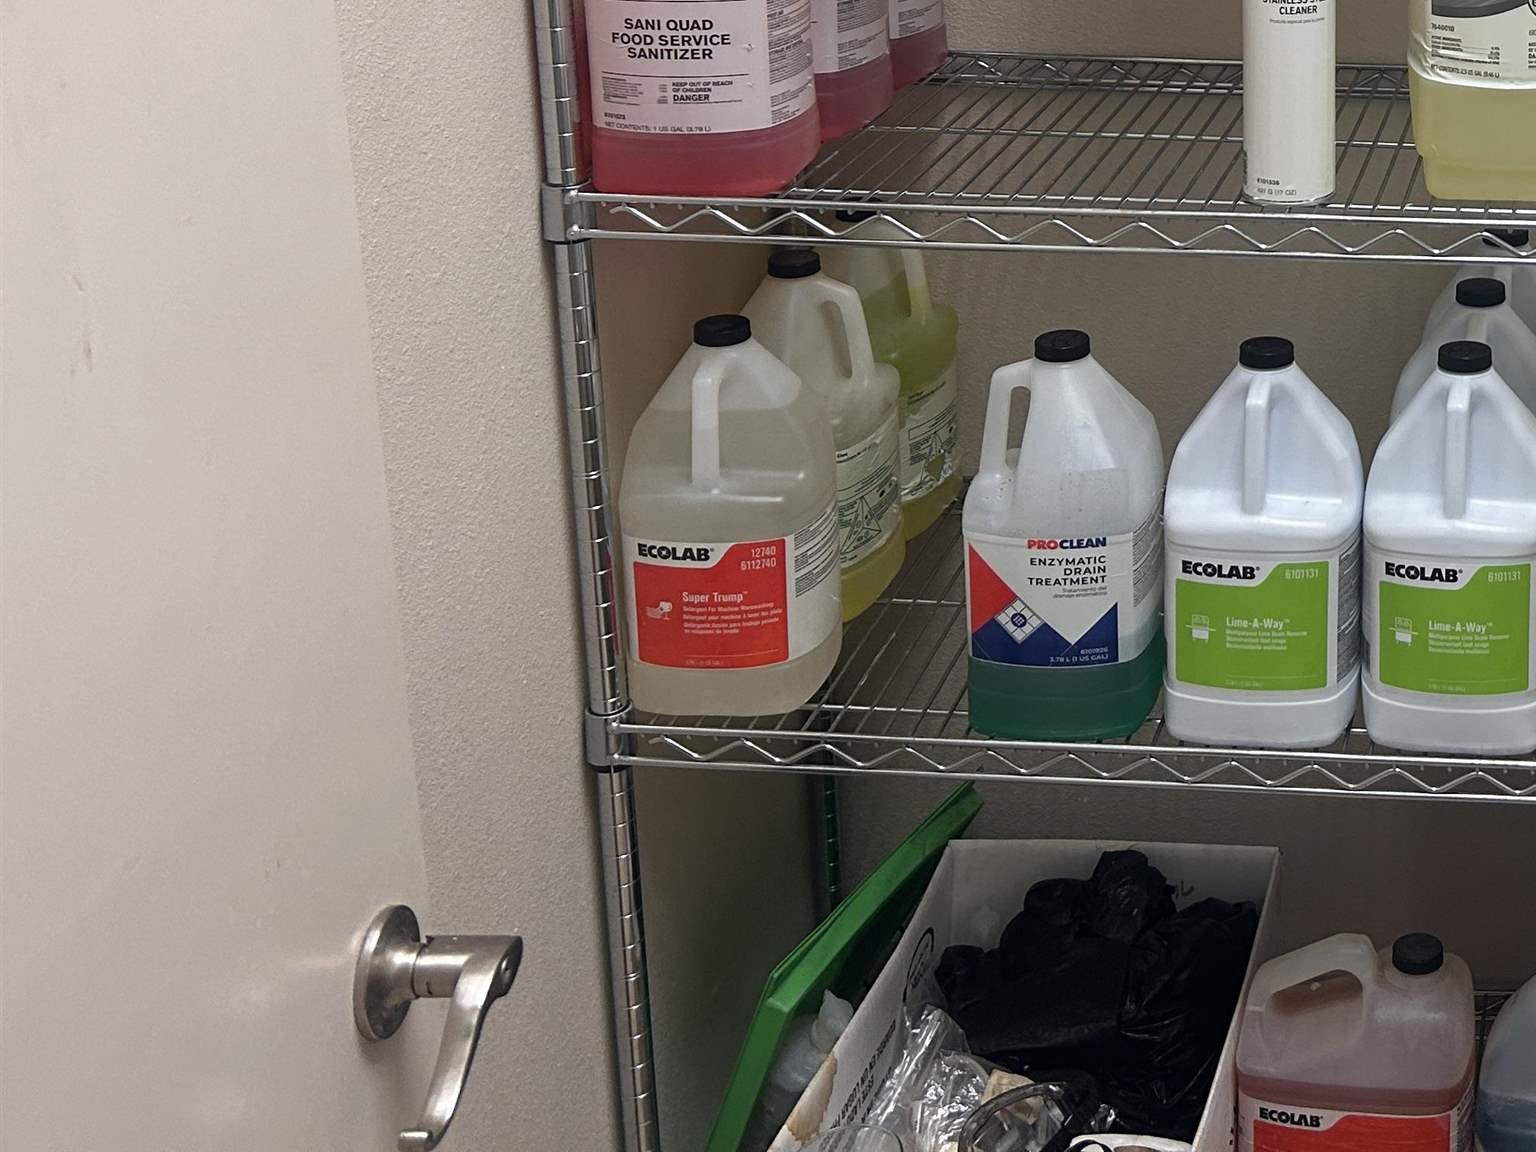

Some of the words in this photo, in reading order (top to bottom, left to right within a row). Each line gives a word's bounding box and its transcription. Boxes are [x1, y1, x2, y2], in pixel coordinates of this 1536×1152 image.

[1279, 5, 1318, 14] CLEANER
[624, 18, 661, 31] SANI
[666, 19, 714, 32] QUAD
[612, 32, 654, 46] FOOD
[658, 34, 731, 47] SERVICE
[627, 48, 713, 60] SANITIZER
[672, 94, 710, 102] DANGER
[1028, 536, 1107, 550] PROCLEAN
[637, 542, 710, 562] ECOLAB
[751, 546, 776, 558] 12740
[740, 559, 777, 571] 6112740
[1030, 555, 1106, 566] ENZYMATIC
[1063, 565, 1106, 576] DRAIN
[1182, 559, 1256, 580] ECOLAB
[1285, 568, 1318, 580] 6101131
[1384, 562, 1458, 583] ECOLAB
[1027, 575, 1108, 586] TREATMENT
[1488, 571, 1521, 583] 6101131
[682, 591, 710, 604] Super
[712, 591, 744, 604] Trump
[1226, 616, 1284, 630] Lime-A-Way
[1428, 620, 1488, 634] Lime-A-Way
[1259, 1107, 1320, 1128] ECOLAB
